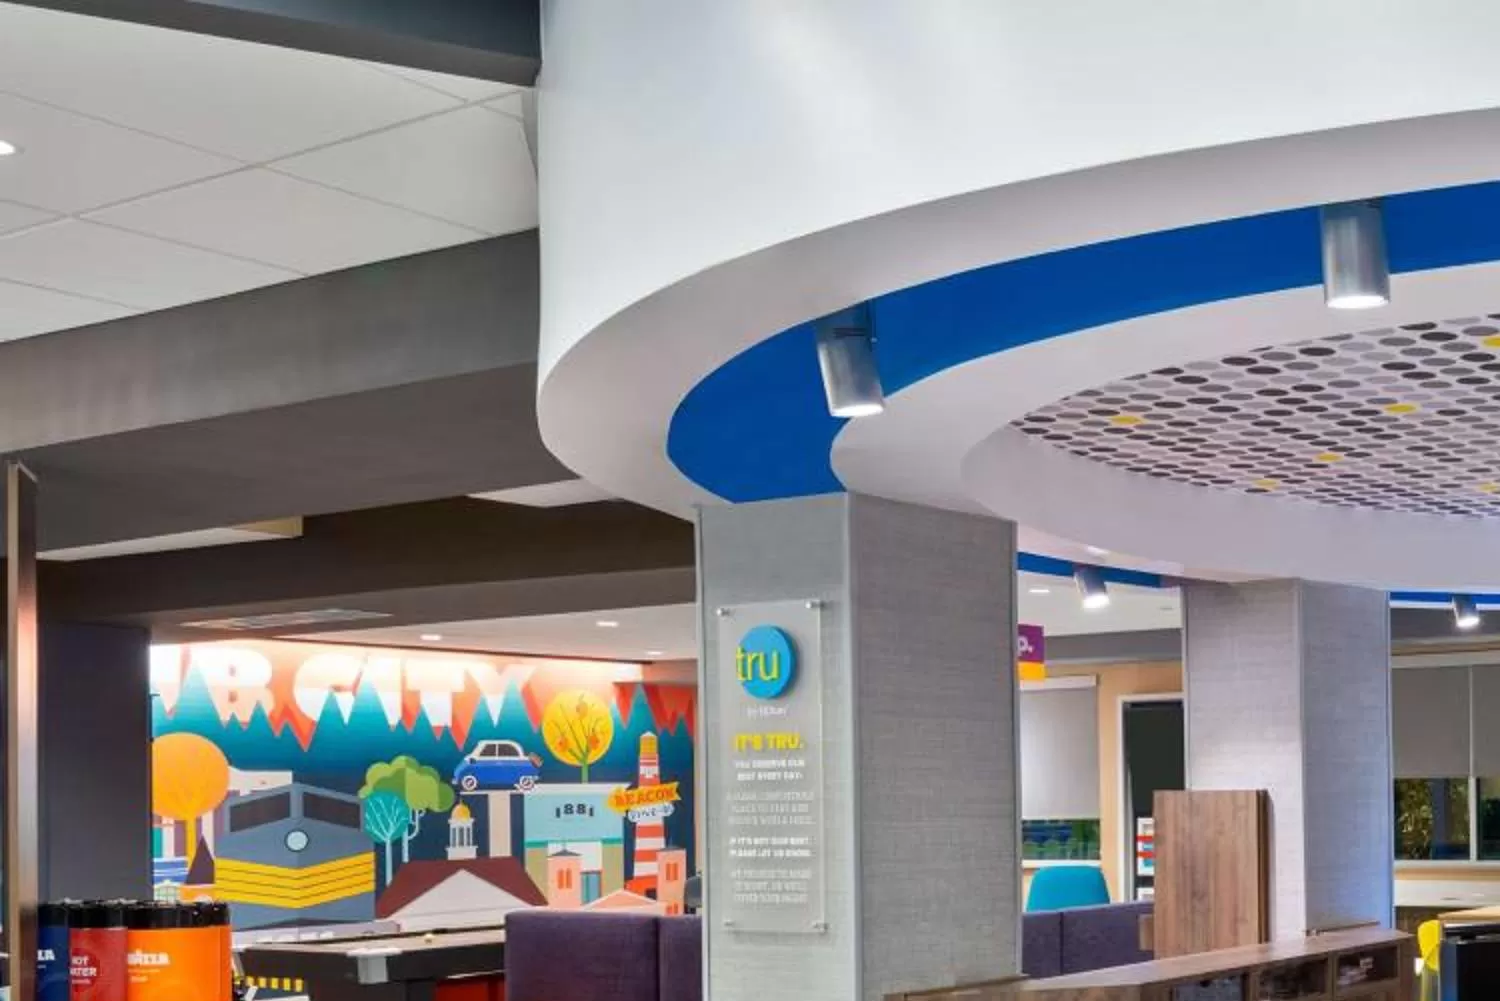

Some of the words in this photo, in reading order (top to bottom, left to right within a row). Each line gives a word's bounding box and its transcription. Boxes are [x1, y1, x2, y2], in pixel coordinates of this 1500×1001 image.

[736, 646, 780, 681] tru
[293, 651, 538, 729] CITY
[555, 803, 595, 819] 1881
[614, 785, 675, 808] BEACON
